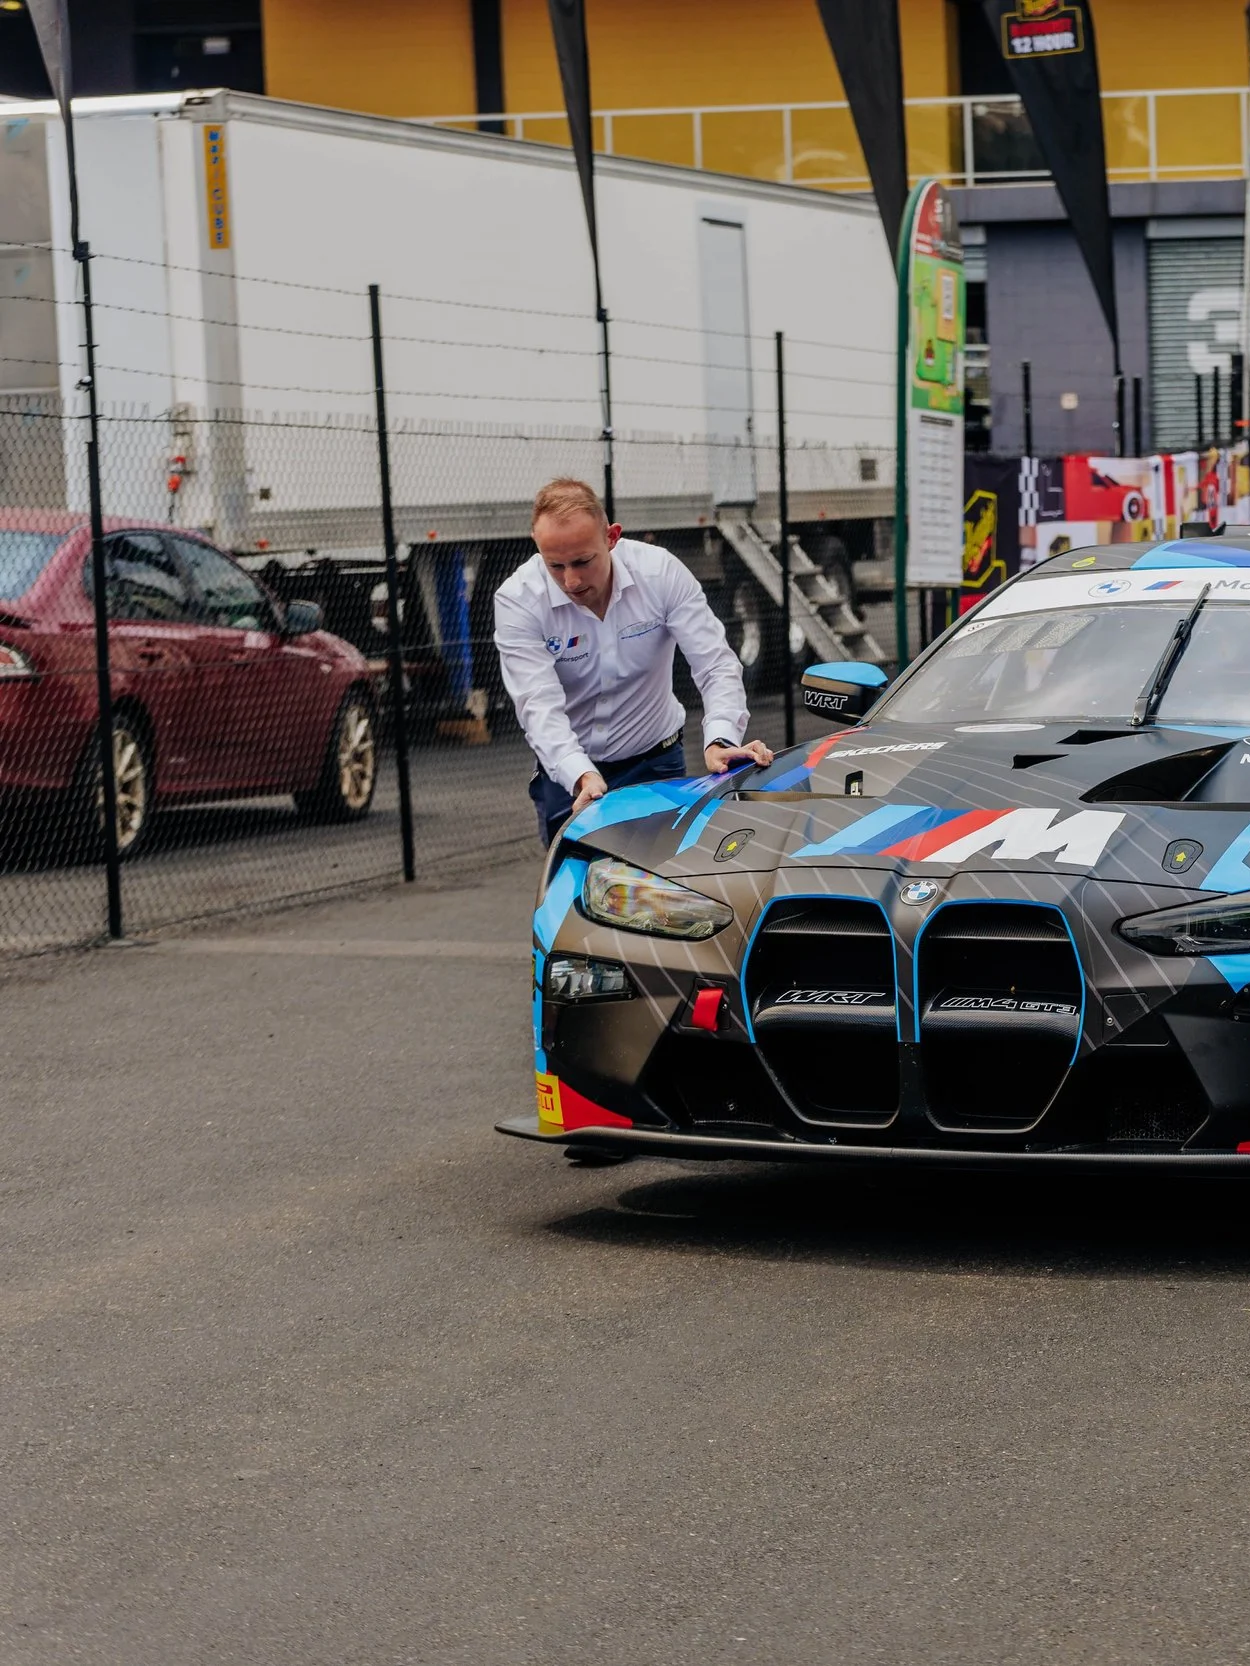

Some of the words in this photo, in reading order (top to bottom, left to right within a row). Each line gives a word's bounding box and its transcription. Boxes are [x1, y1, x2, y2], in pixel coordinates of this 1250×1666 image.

[556, 652, 589, 663] otorsport
[804, 690, 848, 710] WRT
[824, 741, 949, 760] SKECHERS
[919, 808, 1127, 867] M
[775, 990, 886, 1004] WRT
[1019, 1001, 1077, 1015] GT3
